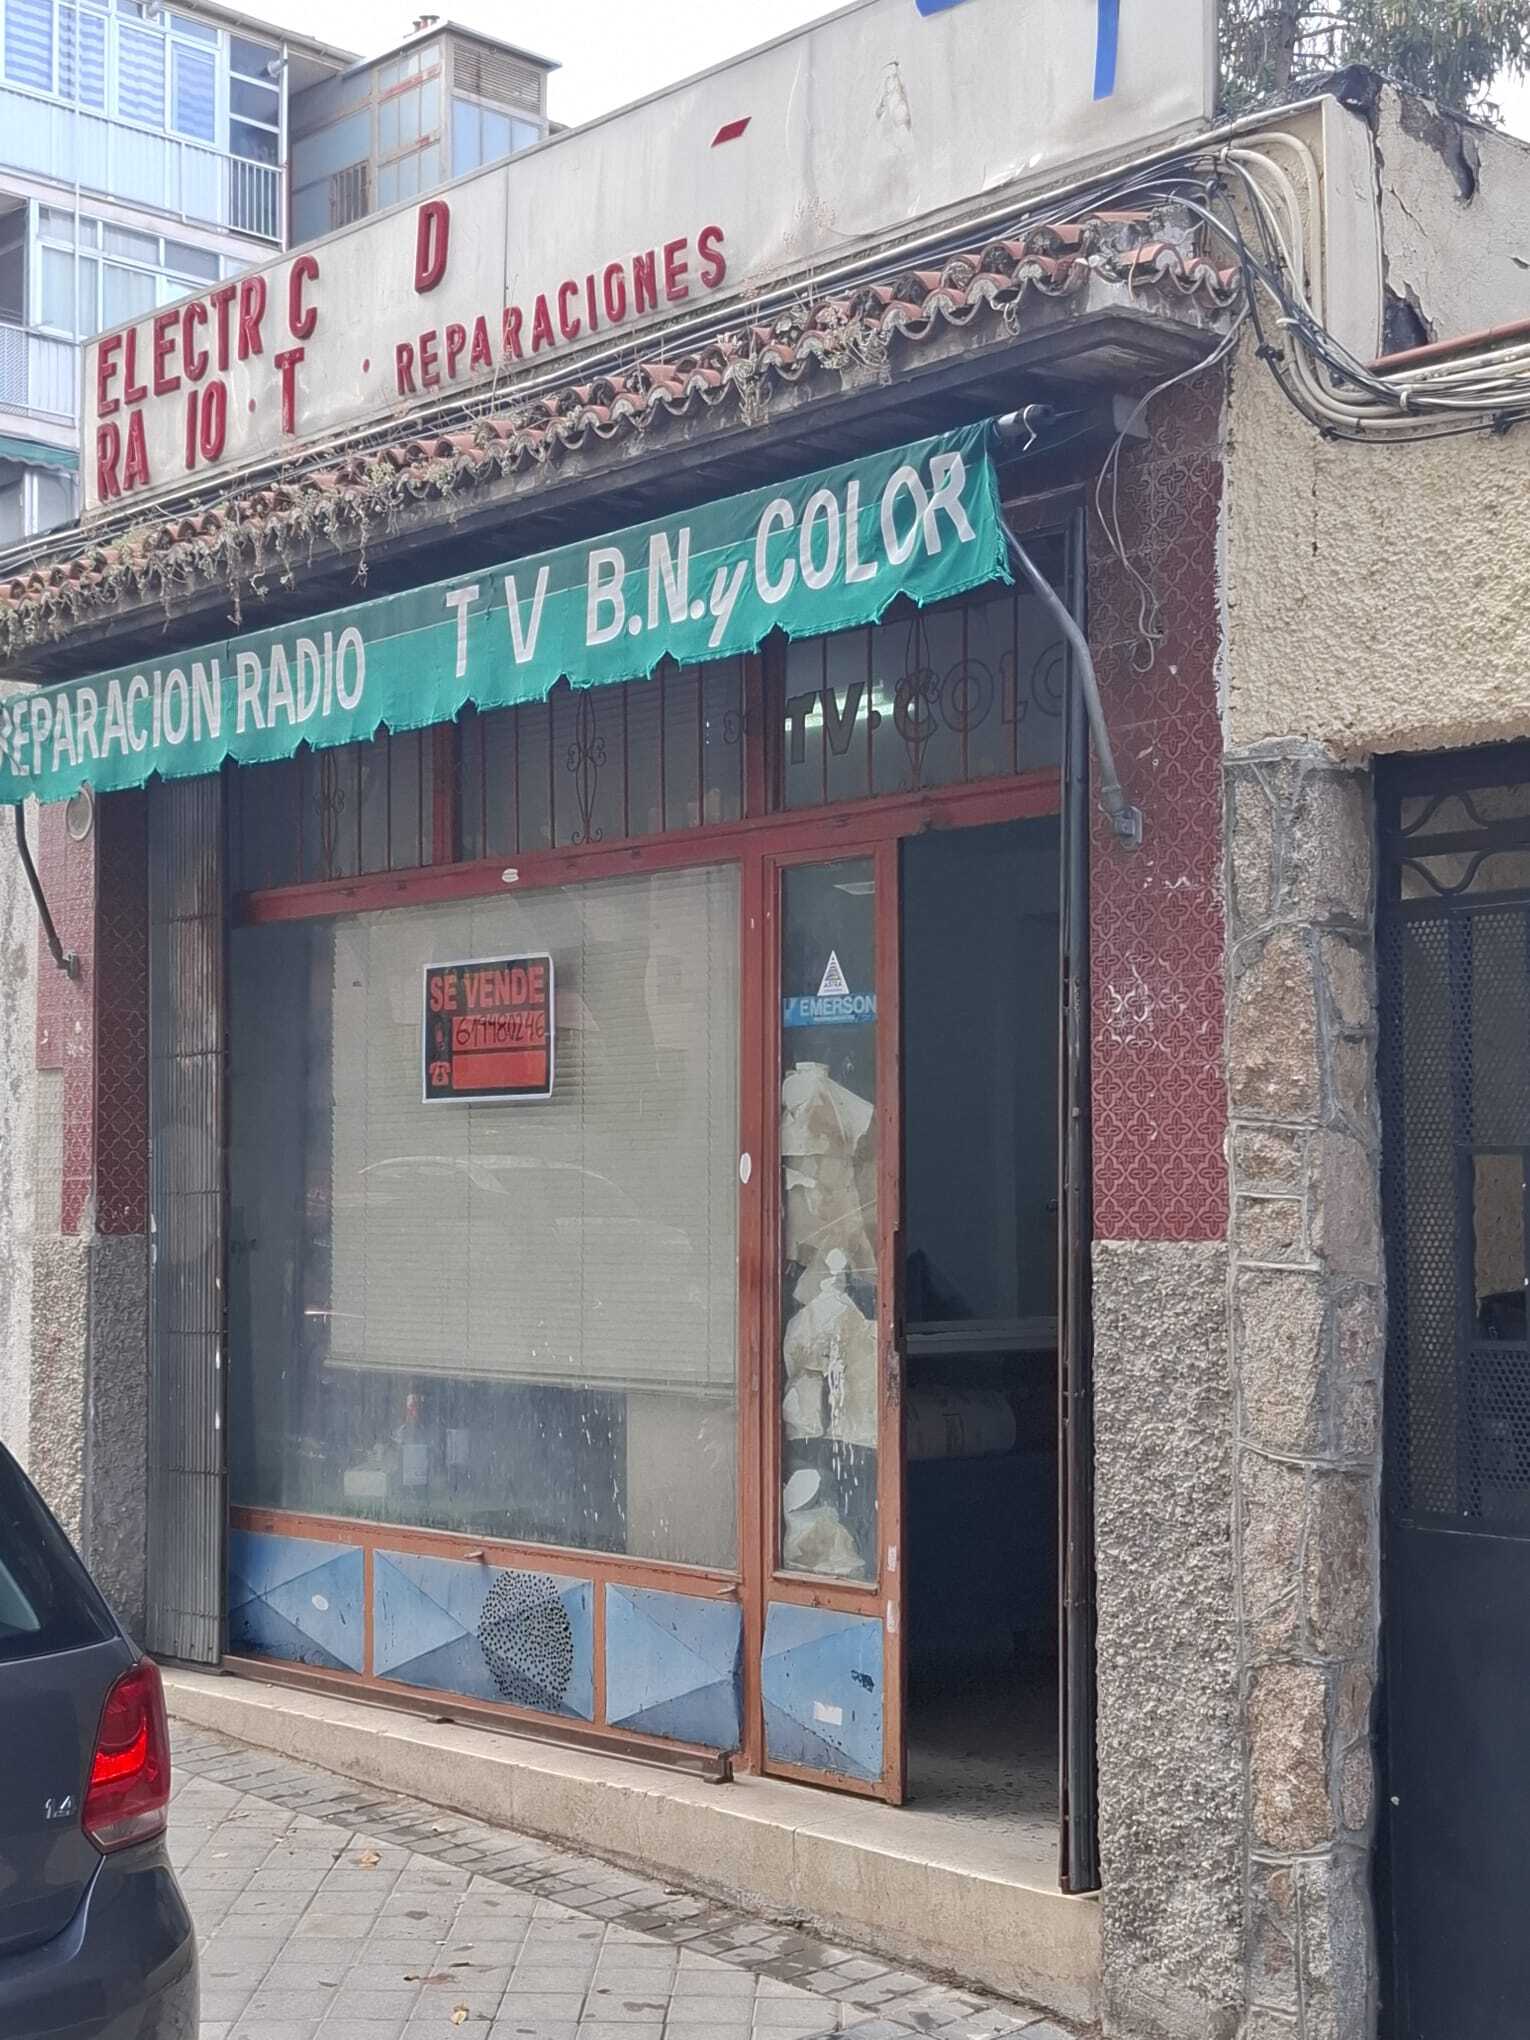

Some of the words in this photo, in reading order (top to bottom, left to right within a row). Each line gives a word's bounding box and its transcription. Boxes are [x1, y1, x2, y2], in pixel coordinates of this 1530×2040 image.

[414, 199, 450, 295] D
[274, 346, 305, 434] T
[395, 224, 727, 396] REPARACIONES
[754, 451, 976, 604] COLOR
[236, 627, 366, 733] RADIO
[430, 974, 458, 1012] SE
[464, 966, 545, 1008] VENDE
[800, 995, 877, 1017] EMERSON
